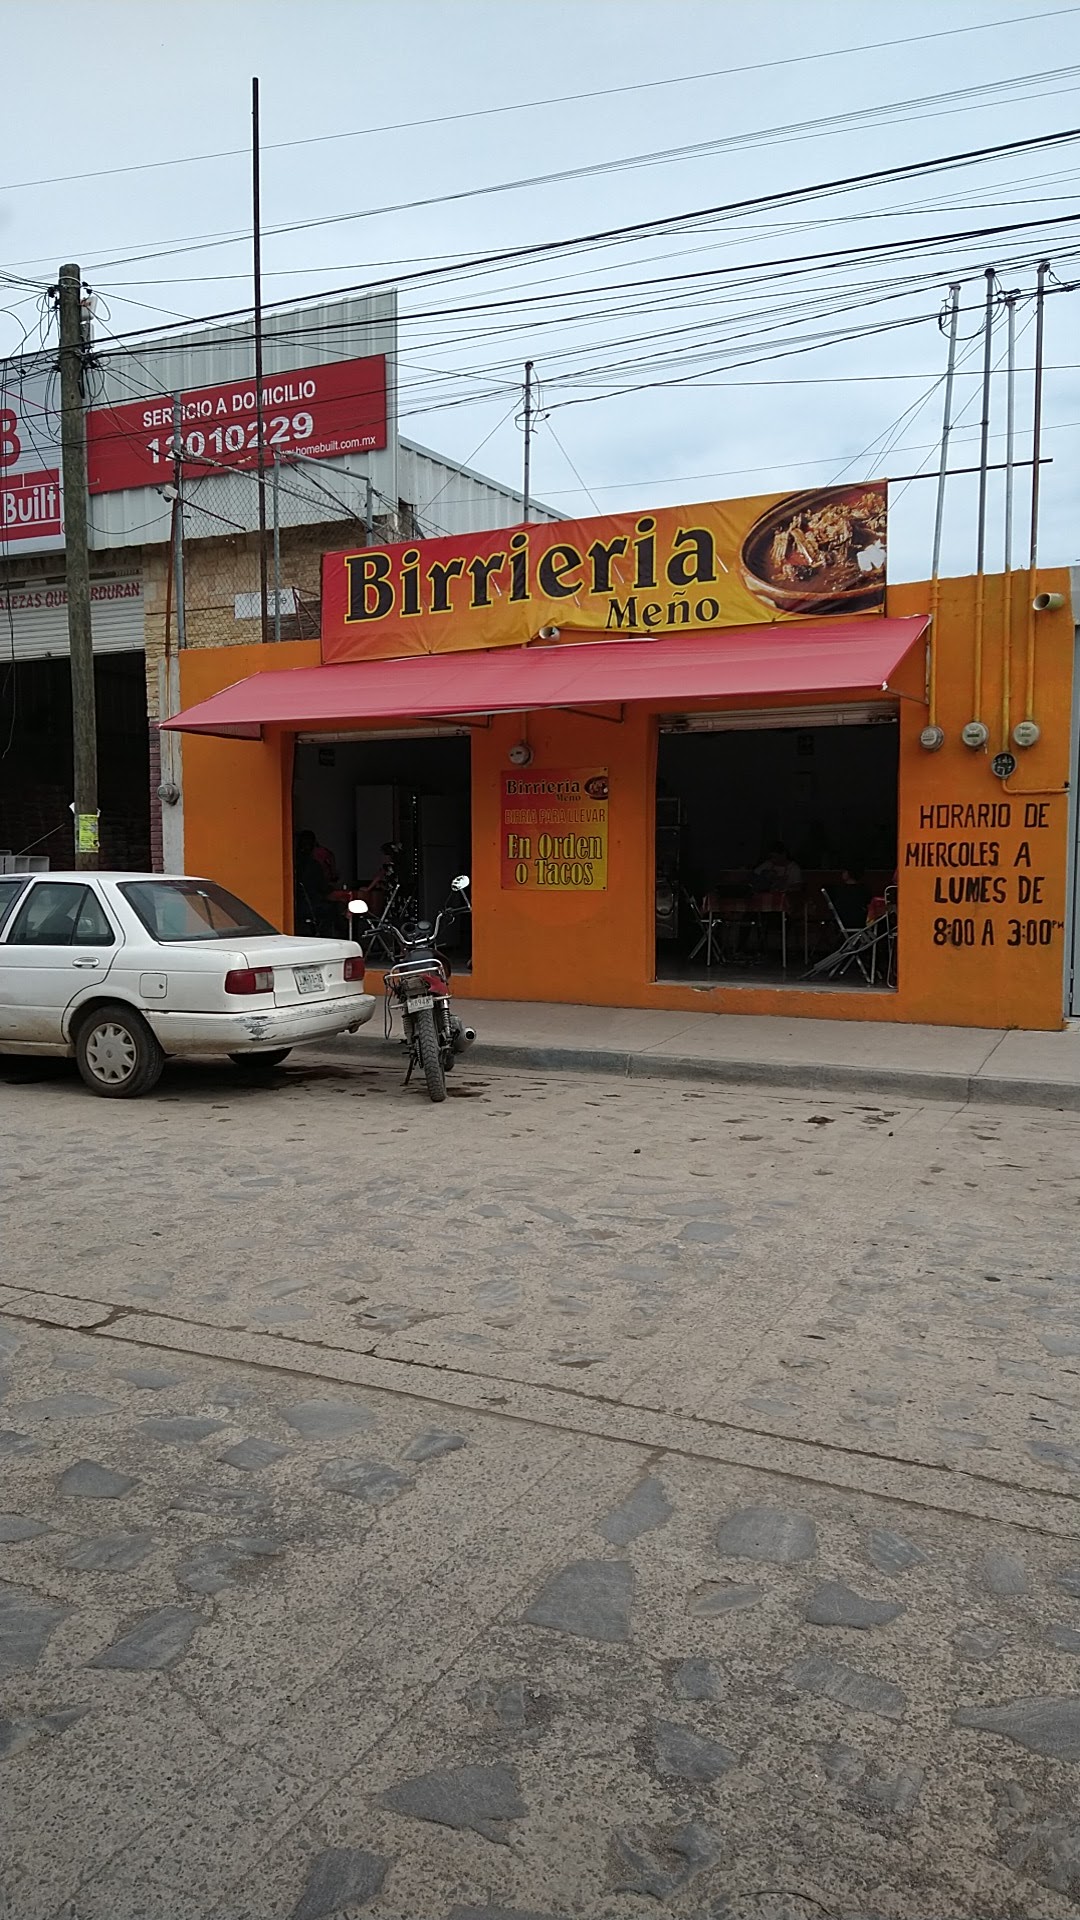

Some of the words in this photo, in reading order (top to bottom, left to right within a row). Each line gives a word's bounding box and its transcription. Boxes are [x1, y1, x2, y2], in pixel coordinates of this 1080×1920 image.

[143, 400, 212, 428] SERICIO
[215, 397, 227, 415] A
[3, 486, 56, 523] Built
[344, 515, 719, 625] Birrieria
[90, 581, 140, 601] RDURAN
[605, 589, 720, 630] Meño
[506, 779, 581, 795] Birrieria
[567, 808, 606, 823] LLEVAR
[919, 803, 1011, 829] HORARIO
[1024, 803, 1050, 828] DE
[507, 832, 532, 860] En
[538, 832, 603, 860] Orden
[905, 842, 1000, 868] MIERCOLES
[1013, 842, 1031, 868] A
[534, 858, 594, 885] Tacos
[1018, 876, 1045, 904] DE
[933, 918, 975, 947] 8:00
[981, 919, 994, 946] A
